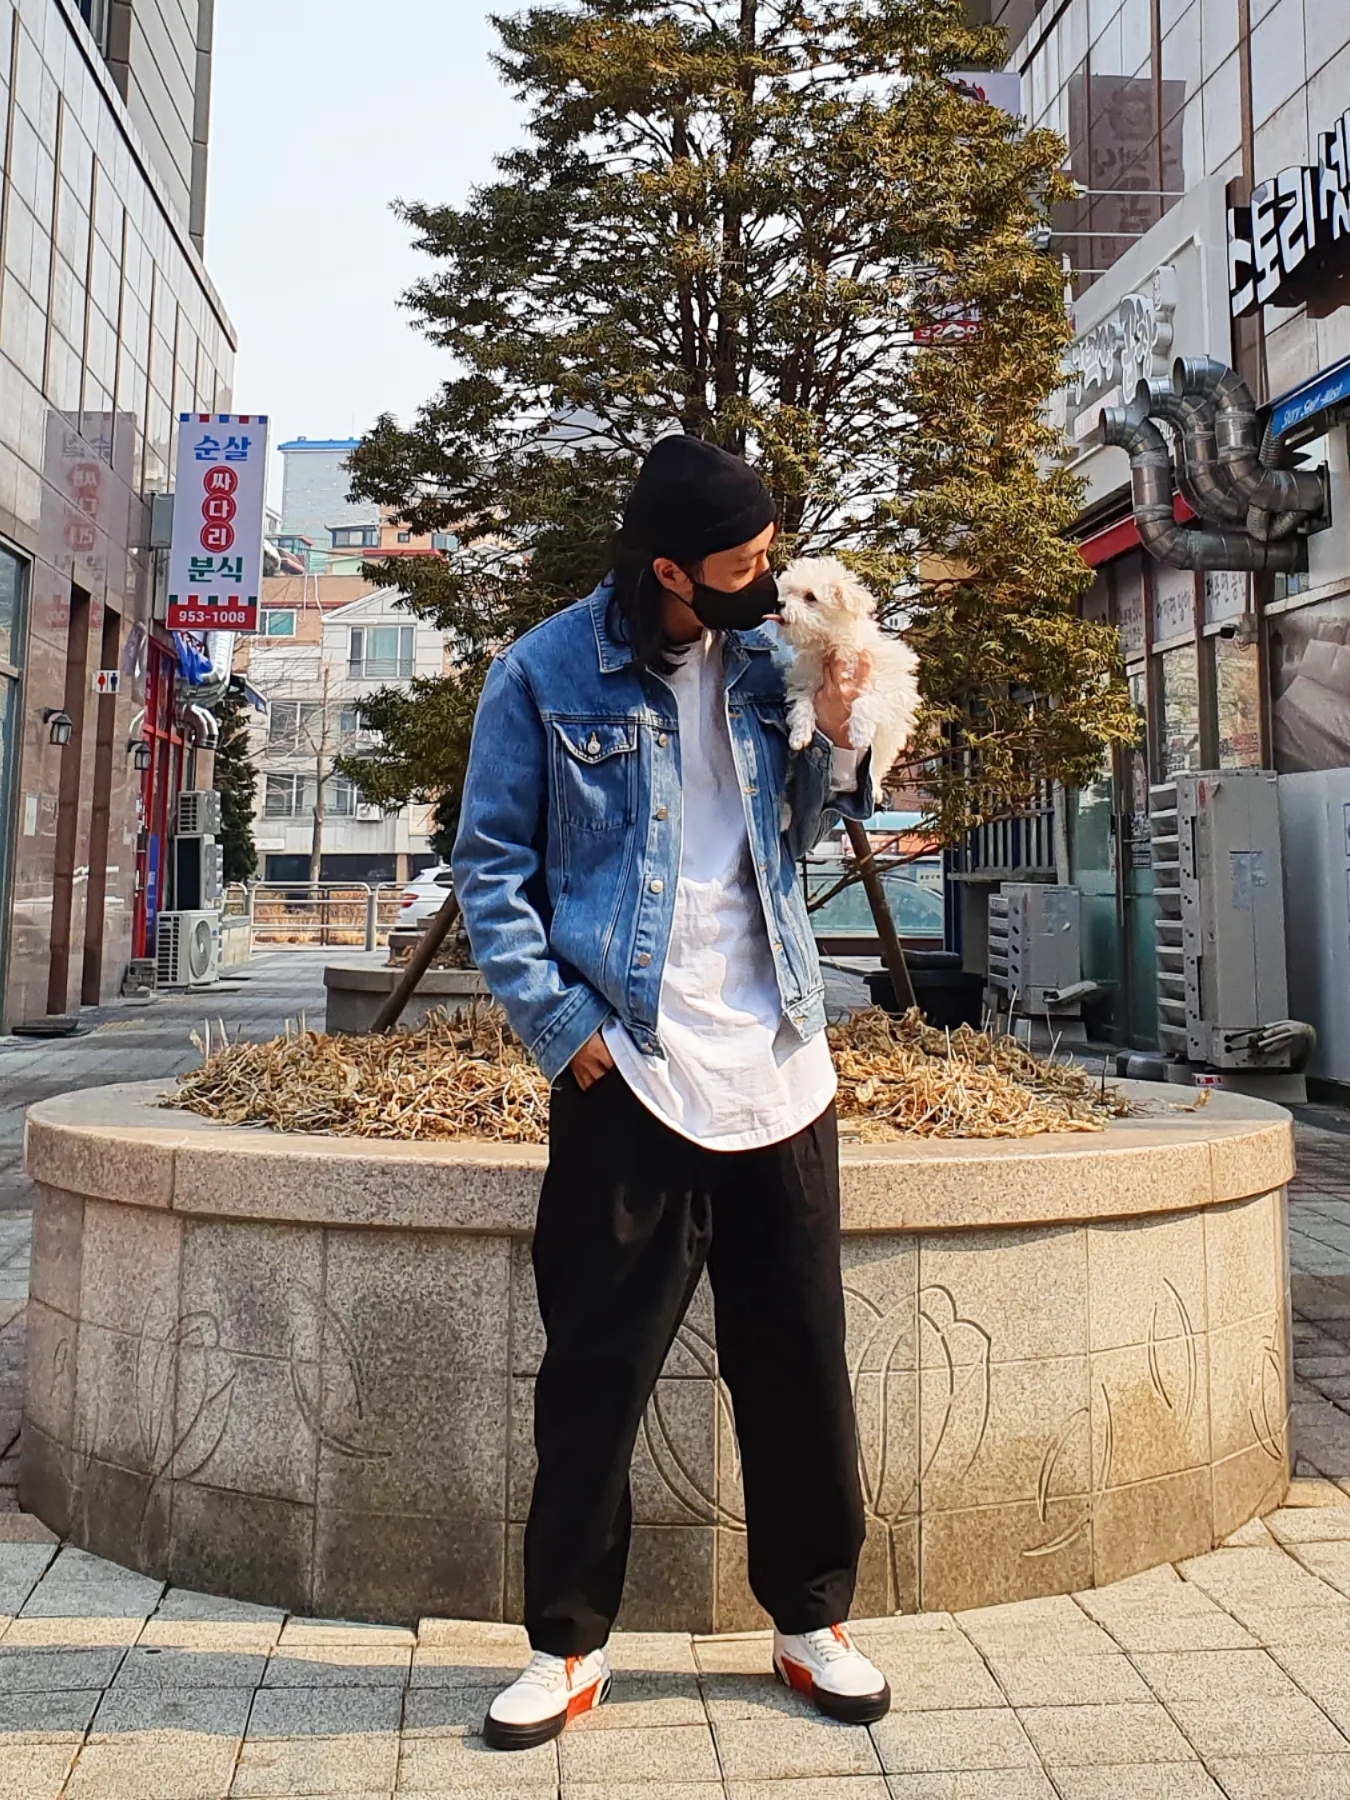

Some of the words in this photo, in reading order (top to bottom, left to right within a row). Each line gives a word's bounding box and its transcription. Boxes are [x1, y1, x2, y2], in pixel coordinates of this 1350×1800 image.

[193, 435, 252, 461] 순살
[187, 556, 243, 583] 분식
[178, 610, 247, 624] 953-1008
